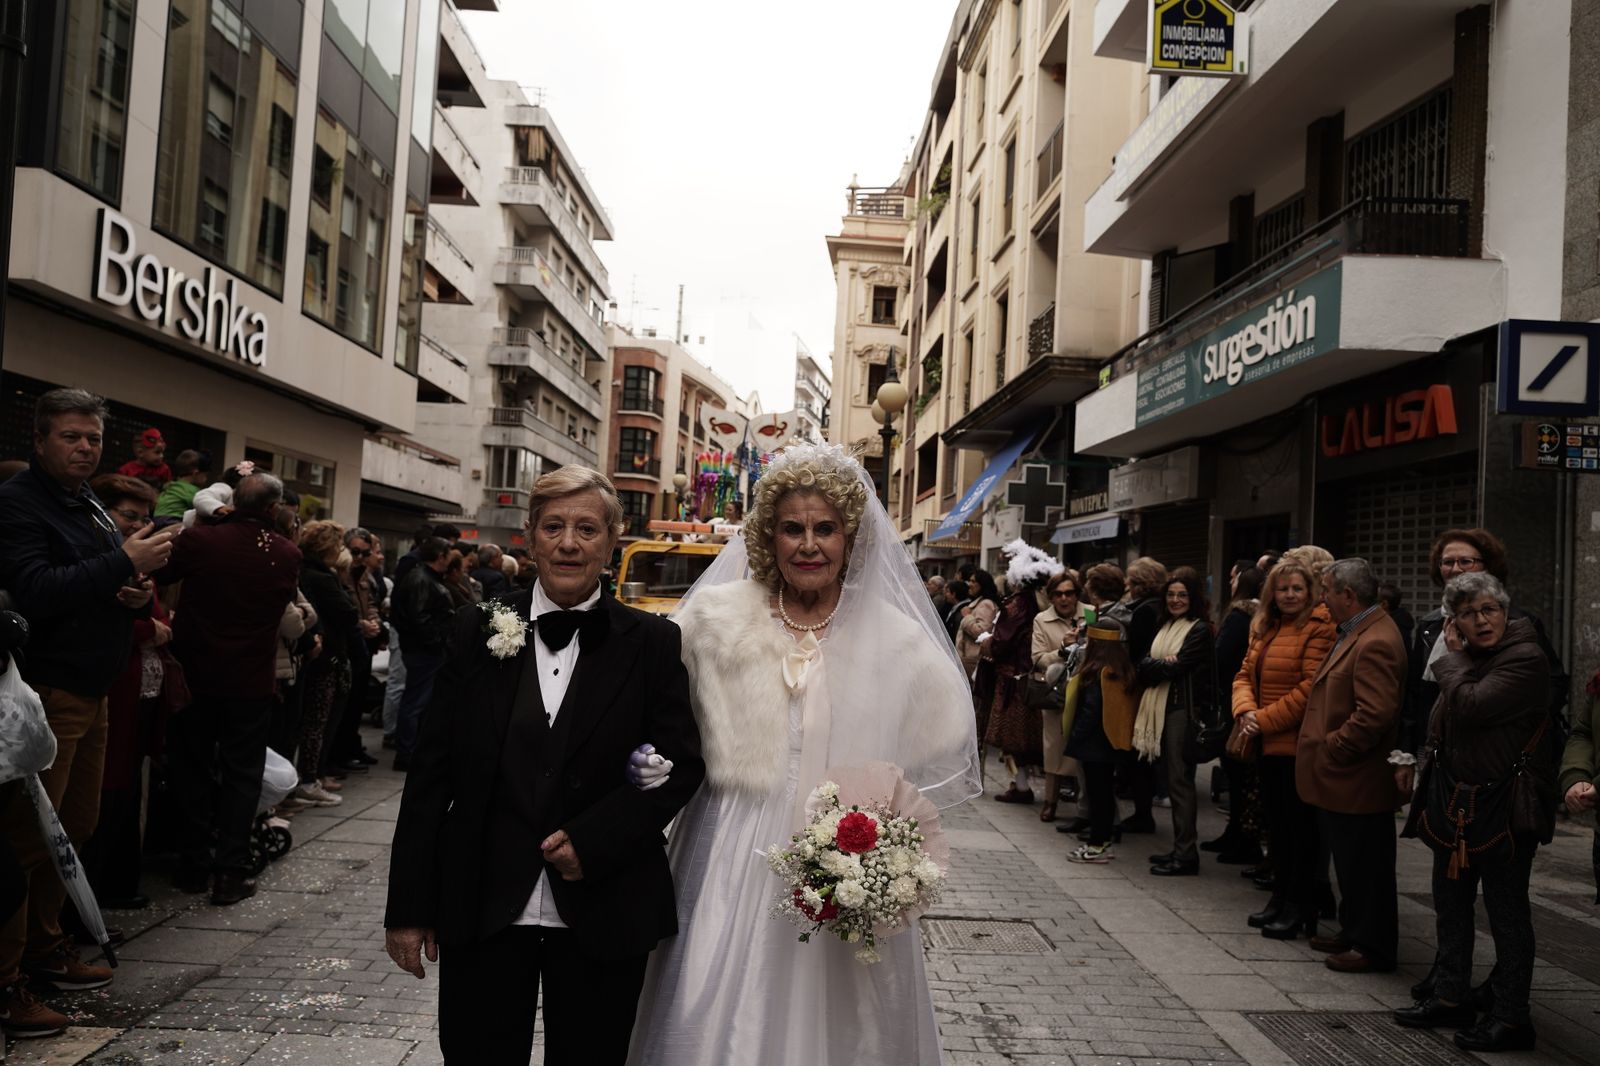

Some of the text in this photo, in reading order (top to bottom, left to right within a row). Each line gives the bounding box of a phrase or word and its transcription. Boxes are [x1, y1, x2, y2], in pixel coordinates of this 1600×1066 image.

[1162, 25, 1226, 43] INMOBILIARIA
[1162, 43, 1225, 62] CONCEPCION
[94, 207, 267, 367] Bershka
[1203, 288, 1317, 386] surgestión
[1282, 344, 1316, 366] empresas
[1321, 384, 1457, 457] LALISA
